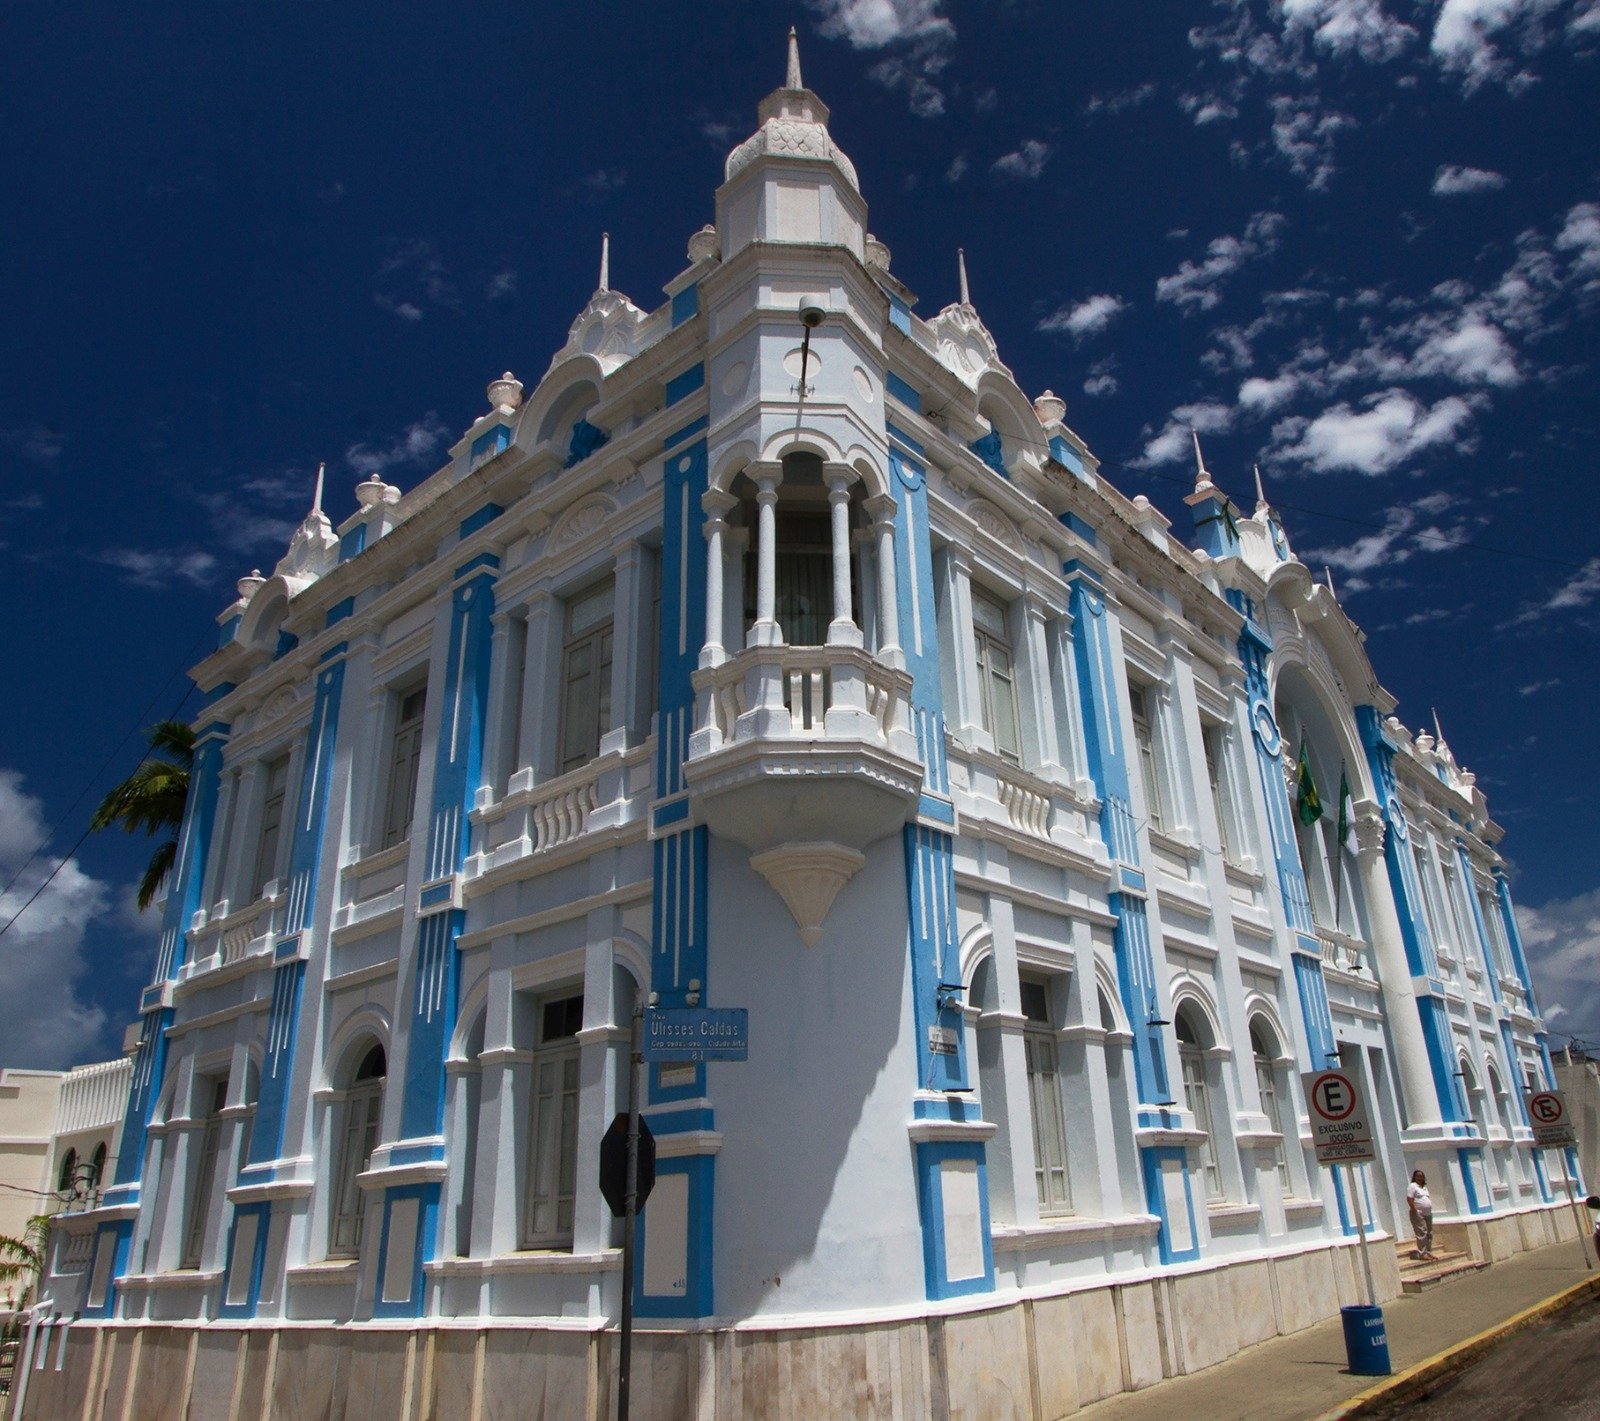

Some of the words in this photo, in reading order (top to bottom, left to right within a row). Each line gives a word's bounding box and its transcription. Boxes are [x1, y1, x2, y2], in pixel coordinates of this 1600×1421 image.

[651, 1021, 694, 1036] Ulisses
[700, 1021, 738, 1036] Caldas
[1323, 1082, 1344, 1112] E
[1318, 1121, 1363, 1134] EXCLUSIVO
[1329, 1133, 1354, 1143] IDOSO
